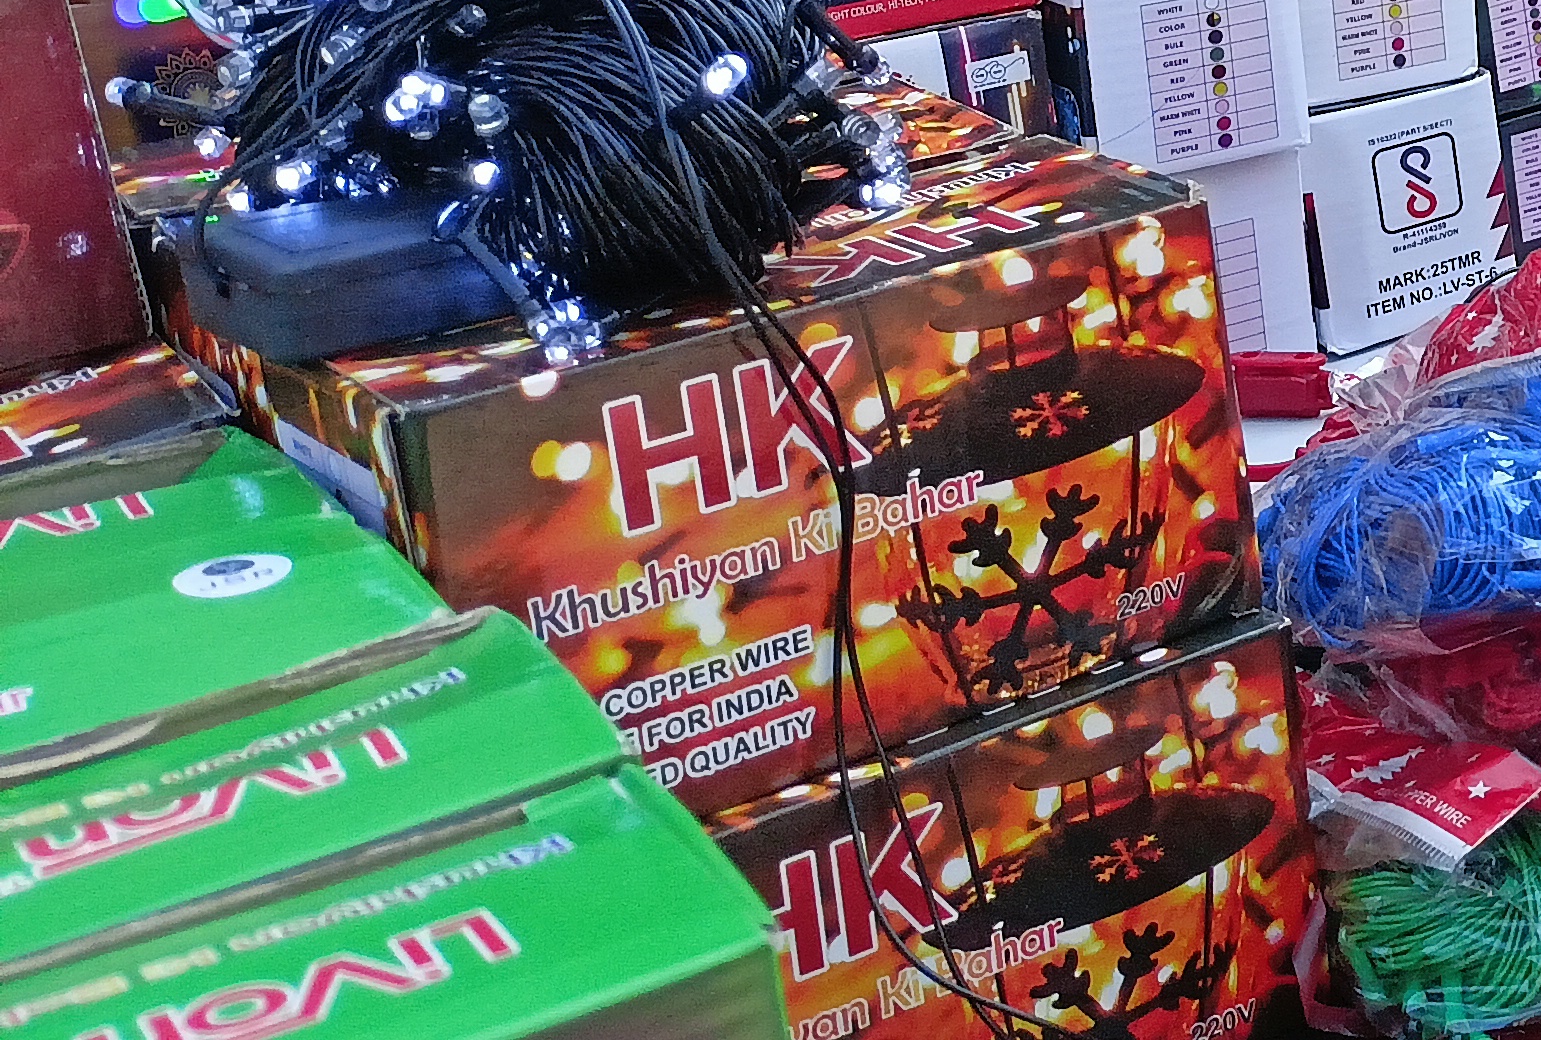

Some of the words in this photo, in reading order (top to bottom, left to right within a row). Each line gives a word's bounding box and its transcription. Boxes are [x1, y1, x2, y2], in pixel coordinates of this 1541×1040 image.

[1158, 22, 1186, 34] COLOR
[1162, 57, 1189, 69] GREEN
[1169, 75, 1186, 85] RED
[1377, 250, 1483, 295] MARK:25TMR
[1366, 294, 1407, 319] ITEM
[601, 334, 874, 540] HK
[526, 533, 781, 642] Khushiyan
[787, 505, 839, 564] Ki
[851, 466, 985, 547] Bahar
[1114, 571, 1187, 622] 220V
[601, 655, 733, 721] COPPER
[733, 622, 815, 672] WIRE
[644, 705, 714, 753] FOR
[714, 675, 799, 725] INDIA
[686, 706, 817, 775] QUALITY
[1433, 799, 1473, 829] WIRE
